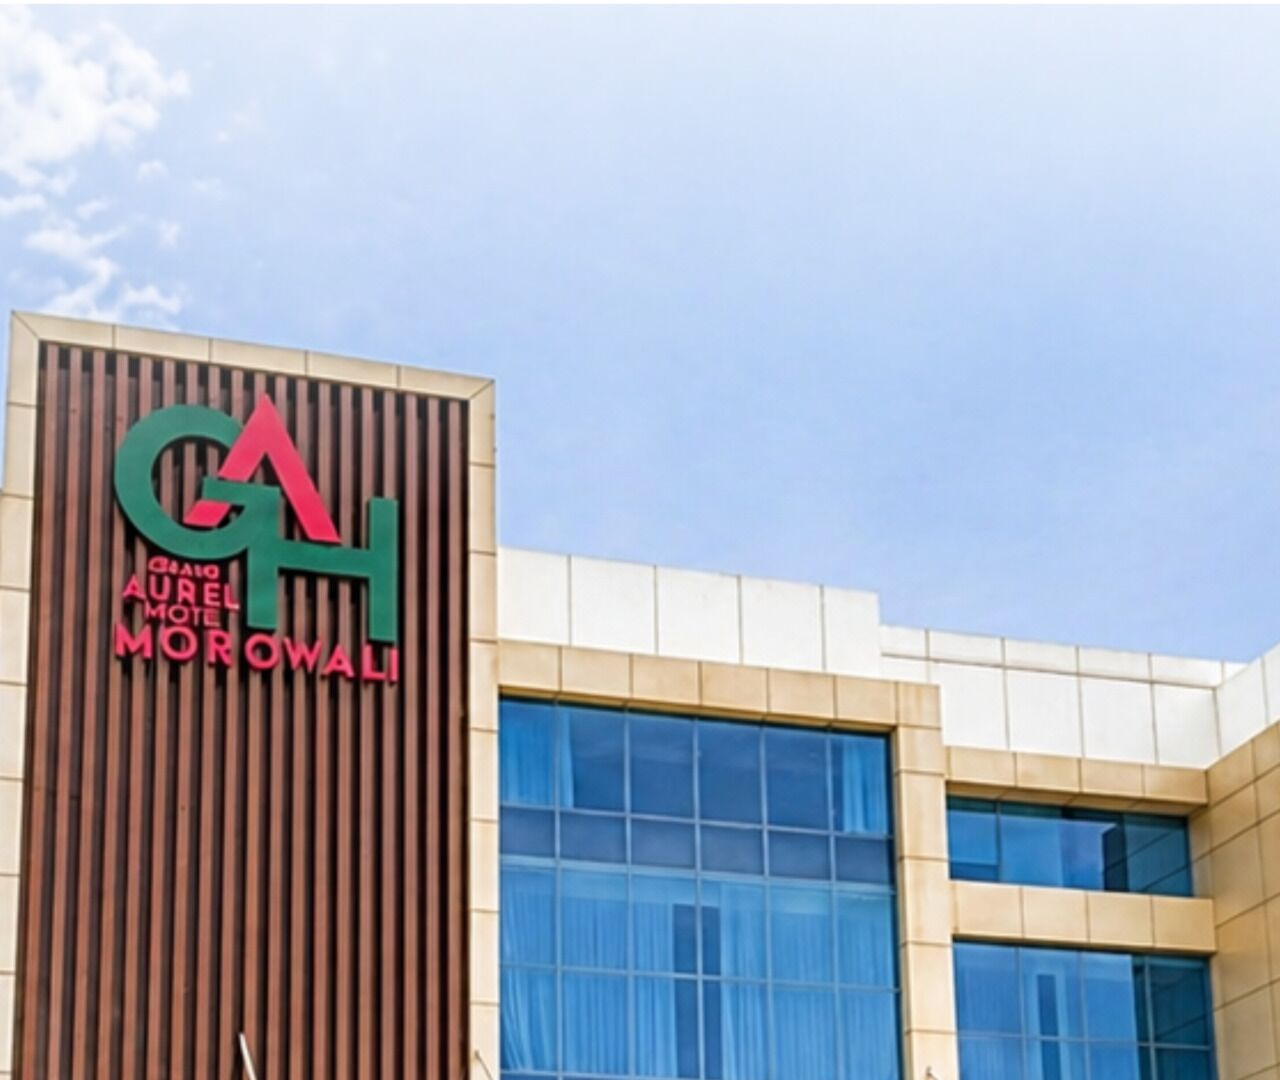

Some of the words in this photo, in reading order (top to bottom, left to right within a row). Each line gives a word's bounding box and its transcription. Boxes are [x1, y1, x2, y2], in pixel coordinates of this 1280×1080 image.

[114, 392, 399, 643] GAH
[123, 574, 240, 611] AUREL
[114, 622, 400, 683] MOROWALI
